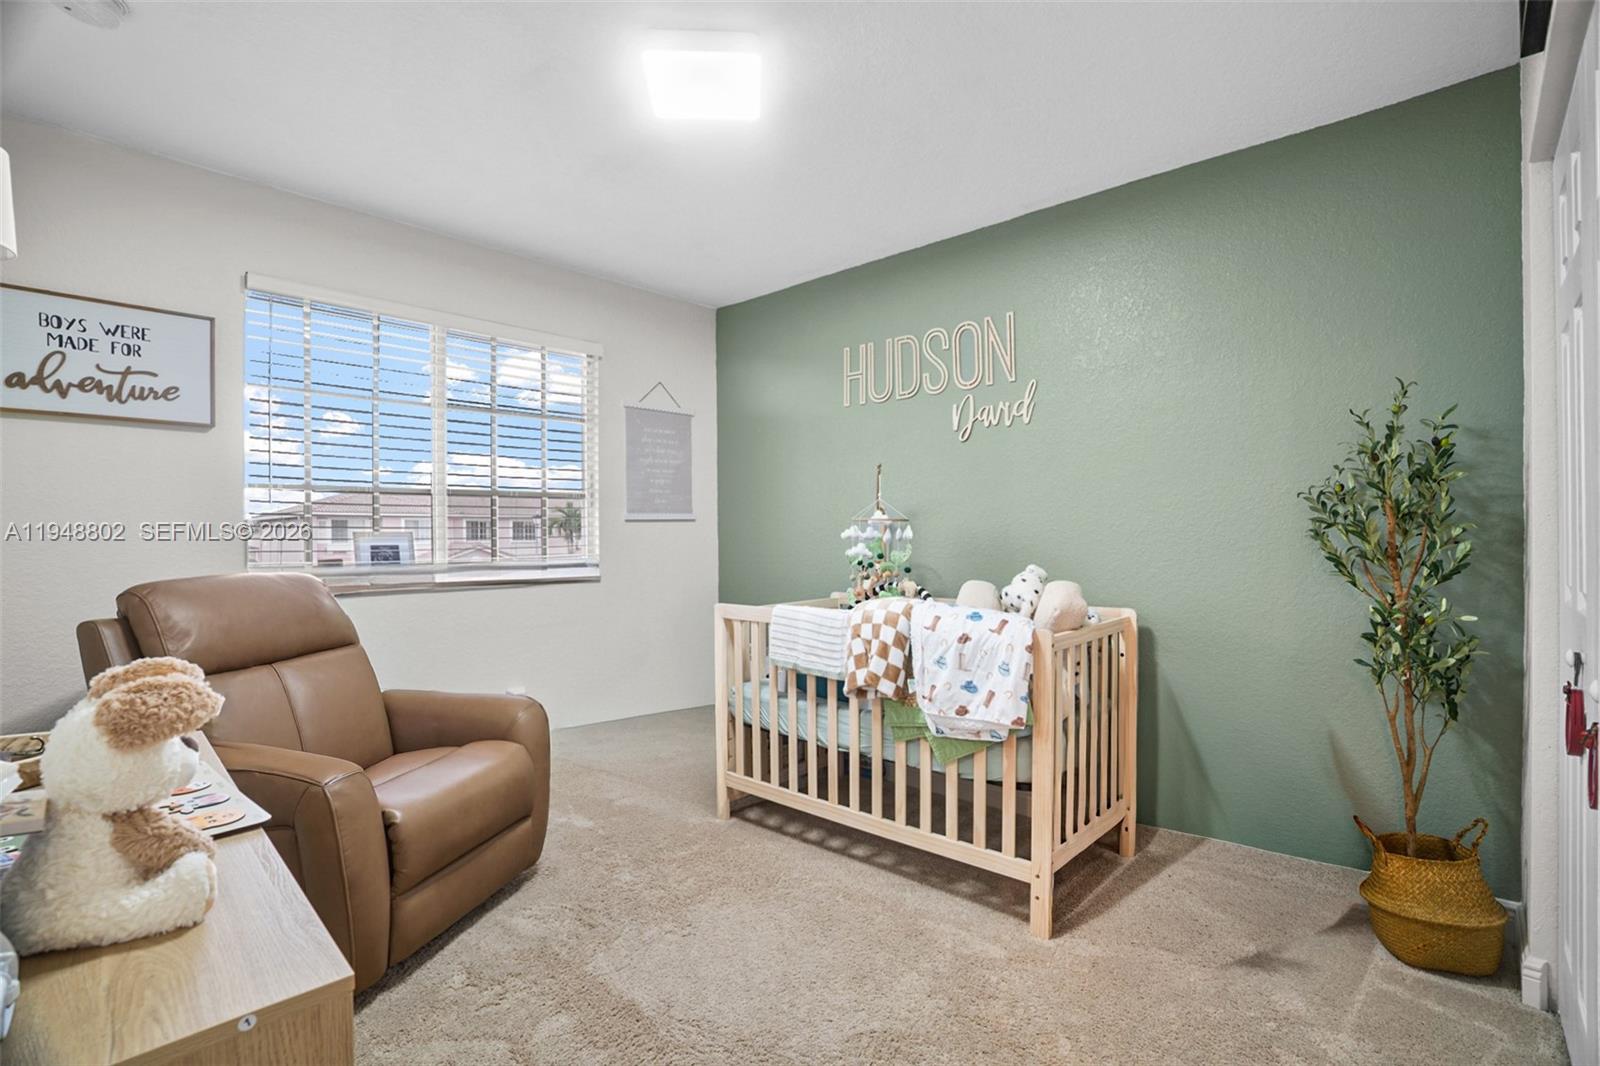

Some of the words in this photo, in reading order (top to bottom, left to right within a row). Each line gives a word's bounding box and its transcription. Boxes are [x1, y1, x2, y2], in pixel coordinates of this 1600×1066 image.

[38, 312, 87, 333] BOYS
[99, 321, 152, 342] WERE
[46, 332, 100, 353] MADE
[111, 341, 142, 358] FOR
[4, 350, 181, 404] adventure
[843, 311, 1016, 407] HUDSON
[952, 378, 1037, 442] David
